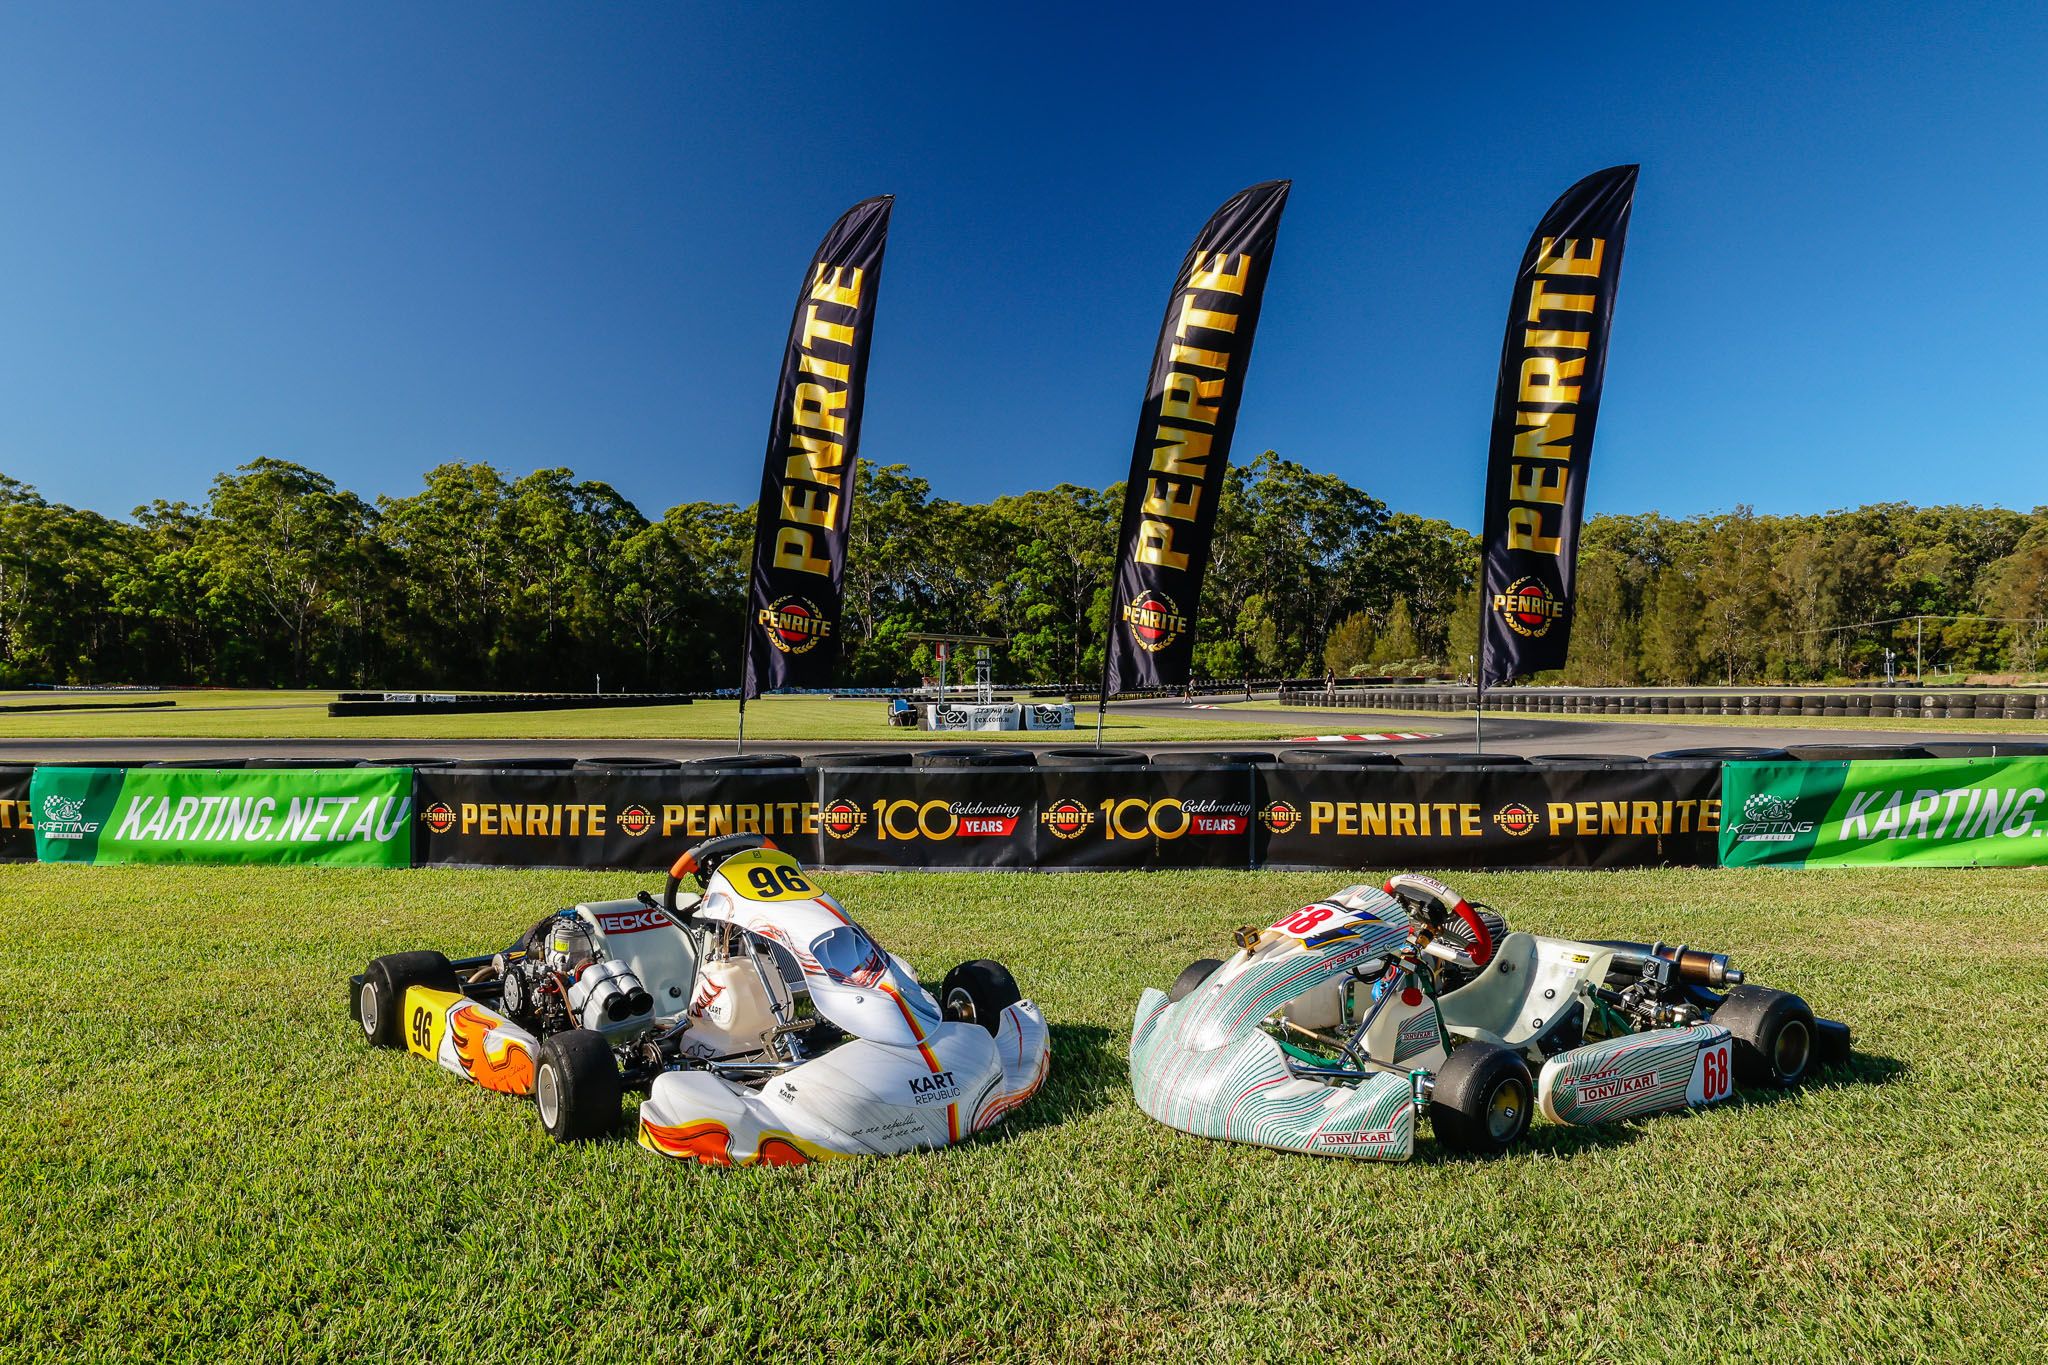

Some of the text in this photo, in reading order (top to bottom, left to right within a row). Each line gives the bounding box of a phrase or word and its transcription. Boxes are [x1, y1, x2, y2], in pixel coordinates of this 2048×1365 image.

[1134, 250, 1251, 571] PENRITE
[1507, 236, 1606, 556] PENRITE
[773, 262, 864, 577] PENRITE
[1122, 605, 1187, 634] PENRITE
[1494, 594, 1563, 619] PENRITE
[758, 608, 831, 638] PENRITE
[114, 796, 411, 842] KARTING.NET.AU
[421, 812, 457, 823] PENRITE
[461, 803, 607, 836] PENRITE
[616, 814, 656, 825] PENRITE
[662, 802, 820, 837] PENRITE
[818, 812, 867, 824] PENRITE
[873, 798, 958, 841] 100
[949, 801, 1021, 818] Celebrating
[1041, 812, 1095, 825] PENRITE
[1100, 798, 1190, 840] 100
[1181, 799, 1251, 816] Celebrating
[1258, 810, 1302, 822] PENRITE
[1309, 801, 1482, 836] PENRITE
[1493, 812, 1539, 824] PENRITE
[1547, 799, 1721, 836] PENRITE
[1838, 788, 2048, 841] KARTING.
[37, 821, 99, 833] KARTING
[965, 820, 1004, 833] YEARS
[1198, 819, 1236, 832] YEARS
[1726, 821, 1815, 834] KARTING
[748, 864, 811, 898] 96
[1271, 905, 1334, 934] 68
[412, 1006, 433, 1053] 96
[908, 1071, 956, 1095] KART
[1703, 1047, 1728, 1100] 68
[779, 1088, 796, 1102] KART
[914, 1087, 961, 1106] REPUBLIC
